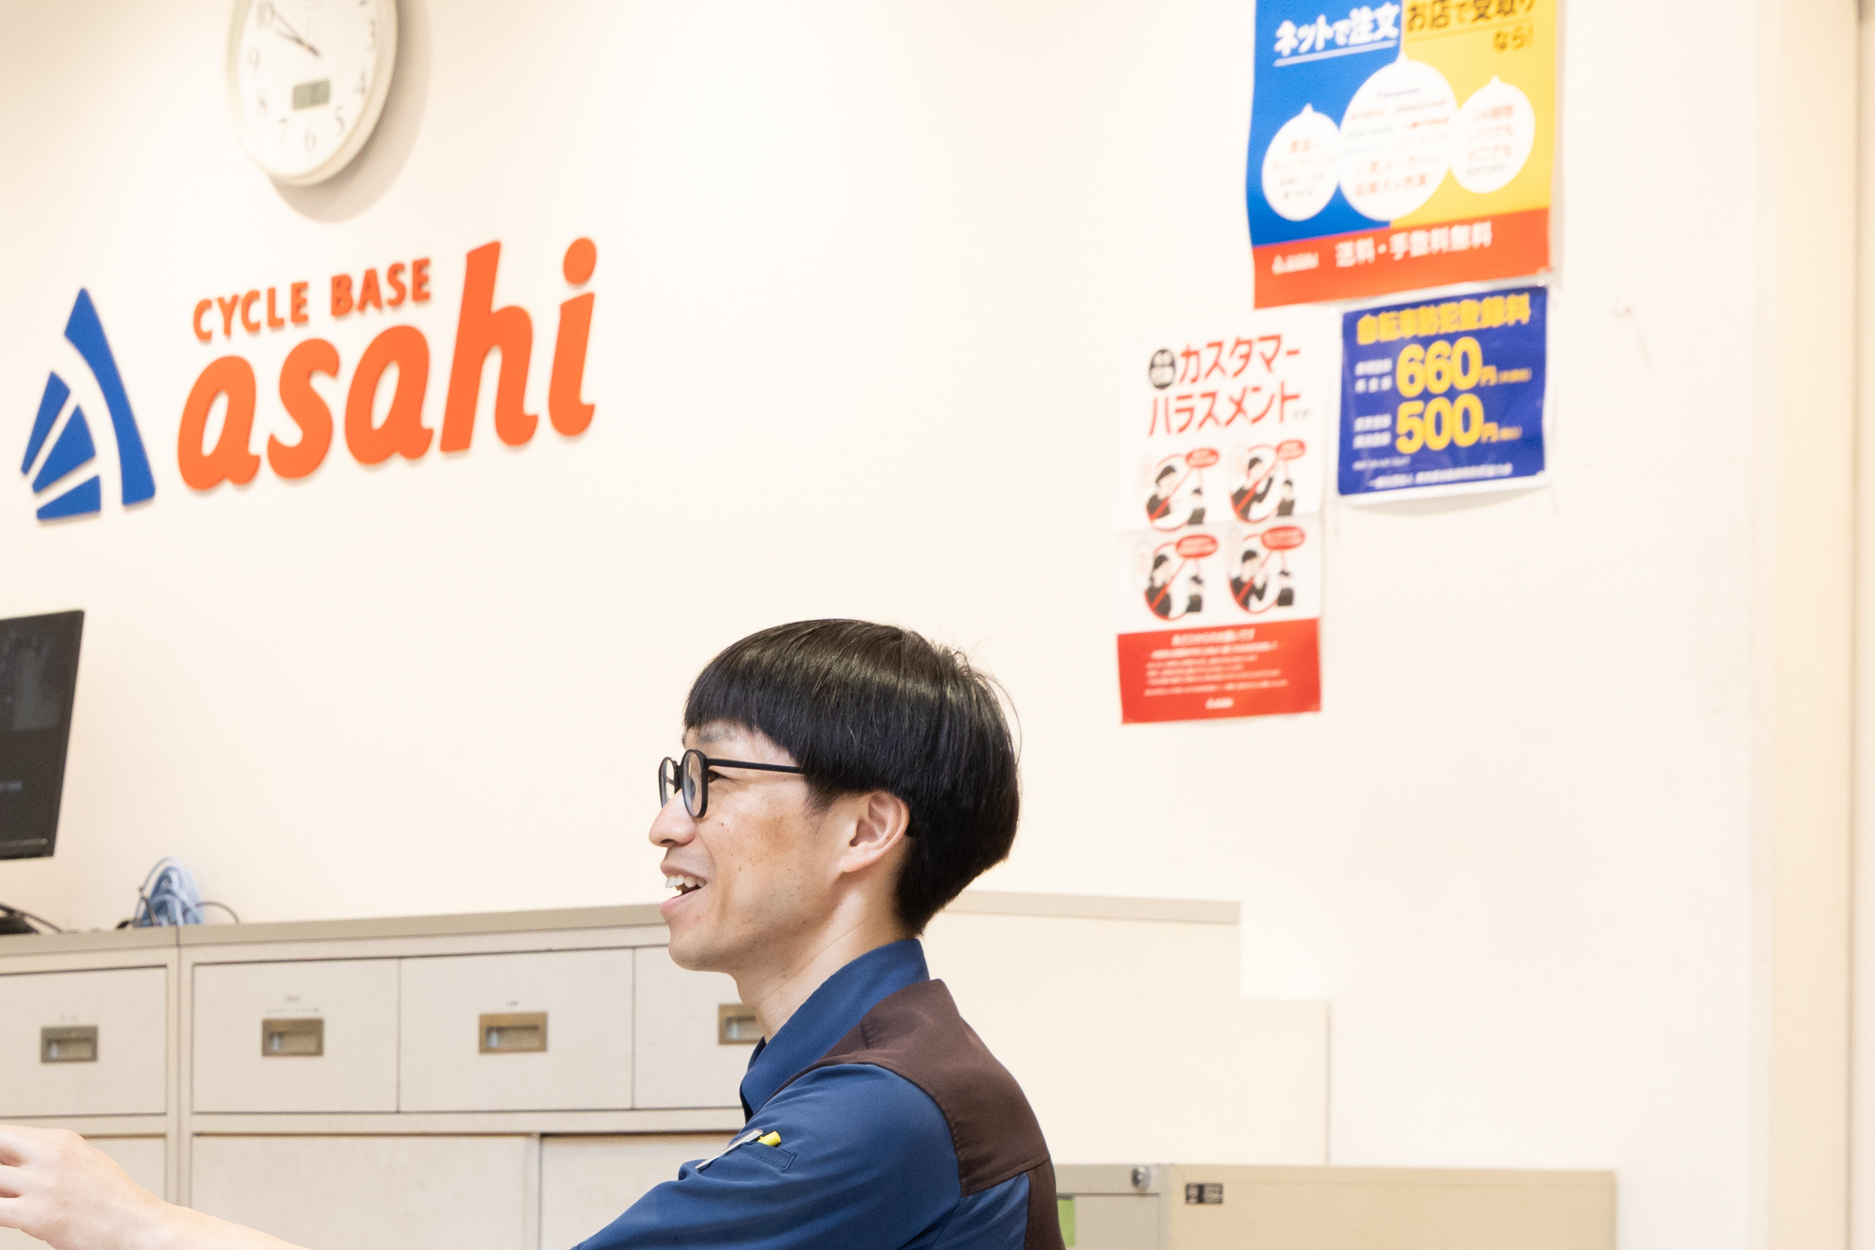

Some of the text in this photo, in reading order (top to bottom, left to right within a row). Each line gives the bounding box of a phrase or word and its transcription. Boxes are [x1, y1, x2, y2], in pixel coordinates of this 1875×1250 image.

[1273, 1, 1400, 58] ネットで注文
[193, 257, 432, 342] CYCLE BASE
[177, 236, 598, 491] asahi
[1178, 334, 1302, 386] カスタマー
[1148, 380, 1302, 437] ハラスメント
